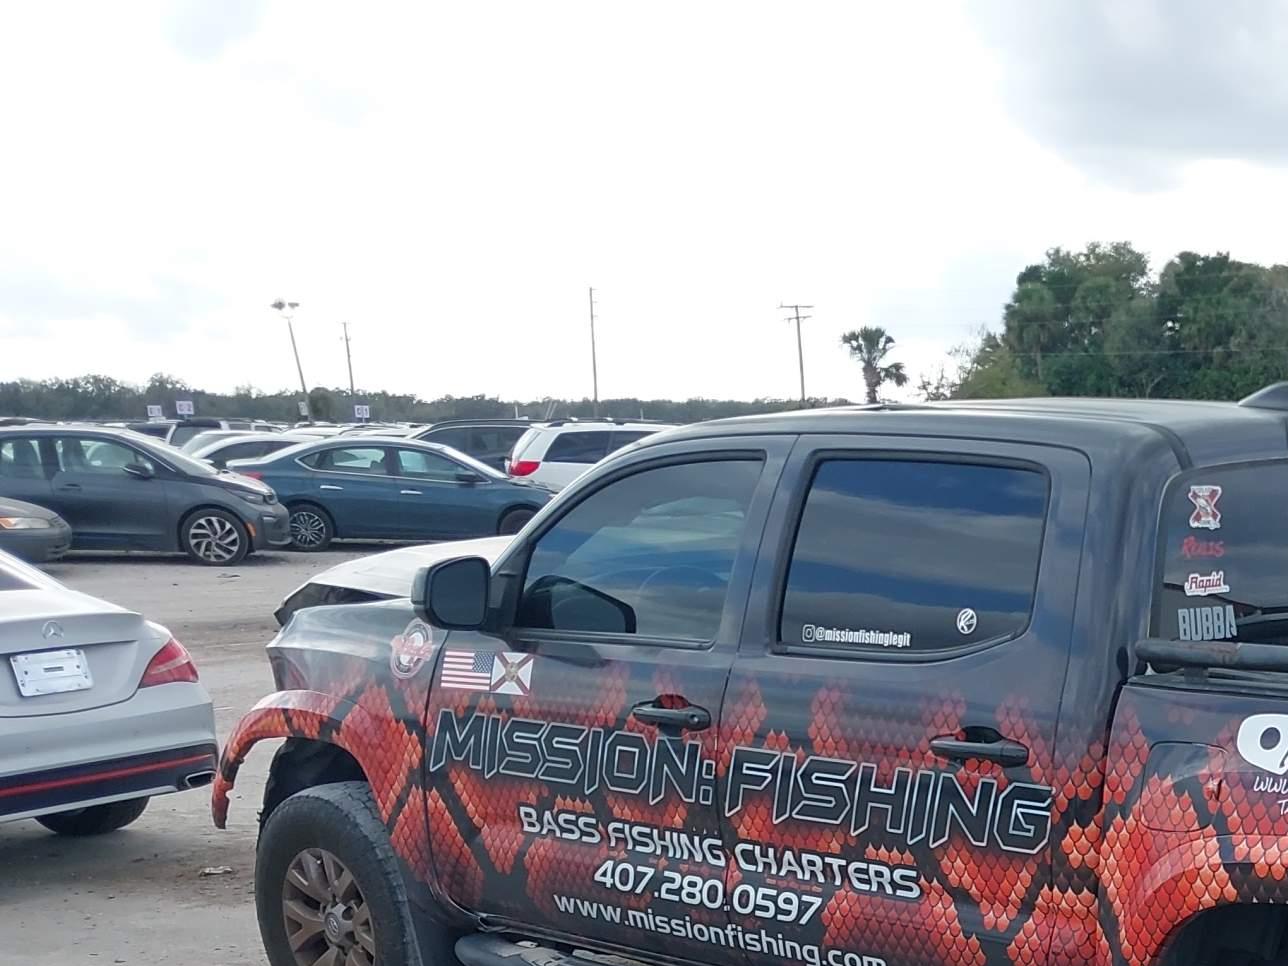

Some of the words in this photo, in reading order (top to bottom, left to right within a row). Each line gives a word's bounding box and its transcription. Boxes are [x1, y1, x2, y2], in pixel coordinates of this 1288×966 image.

[1178, 605, 1237, 641] BUBBA
[429, 708, 716, 806] MISSION:
[724, 746, 1055, 854] FISHING
[519, 806, 601, 844] BASS
[606, 822, 726, 866] FISHING
[735, 842, 922, 899] CHARTERS
[594, 860, 823, 926] 407.280.0597
